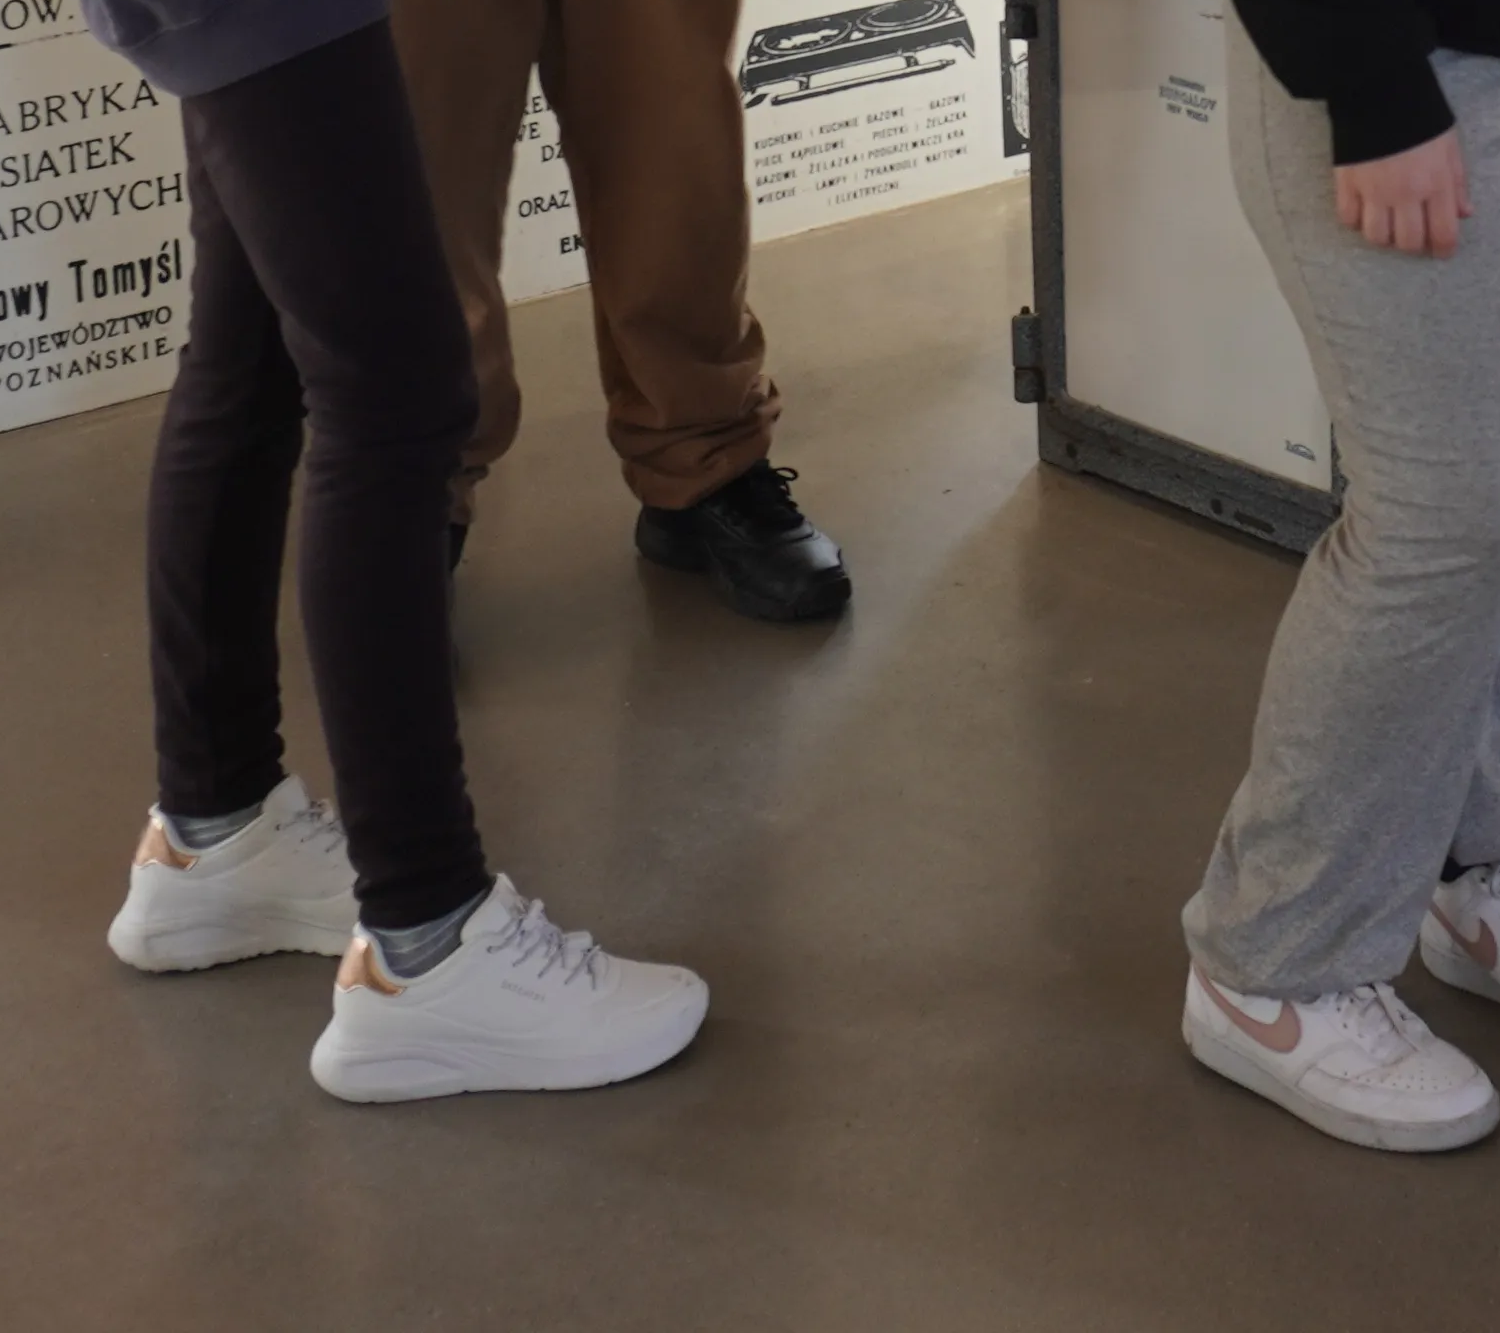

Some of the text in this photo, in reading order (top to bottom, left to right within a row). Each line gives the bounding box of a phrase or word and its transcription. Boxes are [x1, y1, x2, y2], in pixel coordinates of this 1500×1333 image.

[0, 132, 135, 188] SIATEK
[754, 132, 803, 151] KUCHENKI
[518, 190, 570, 217] ORAZ
[68, 239, 183, 304] Tomyśl
